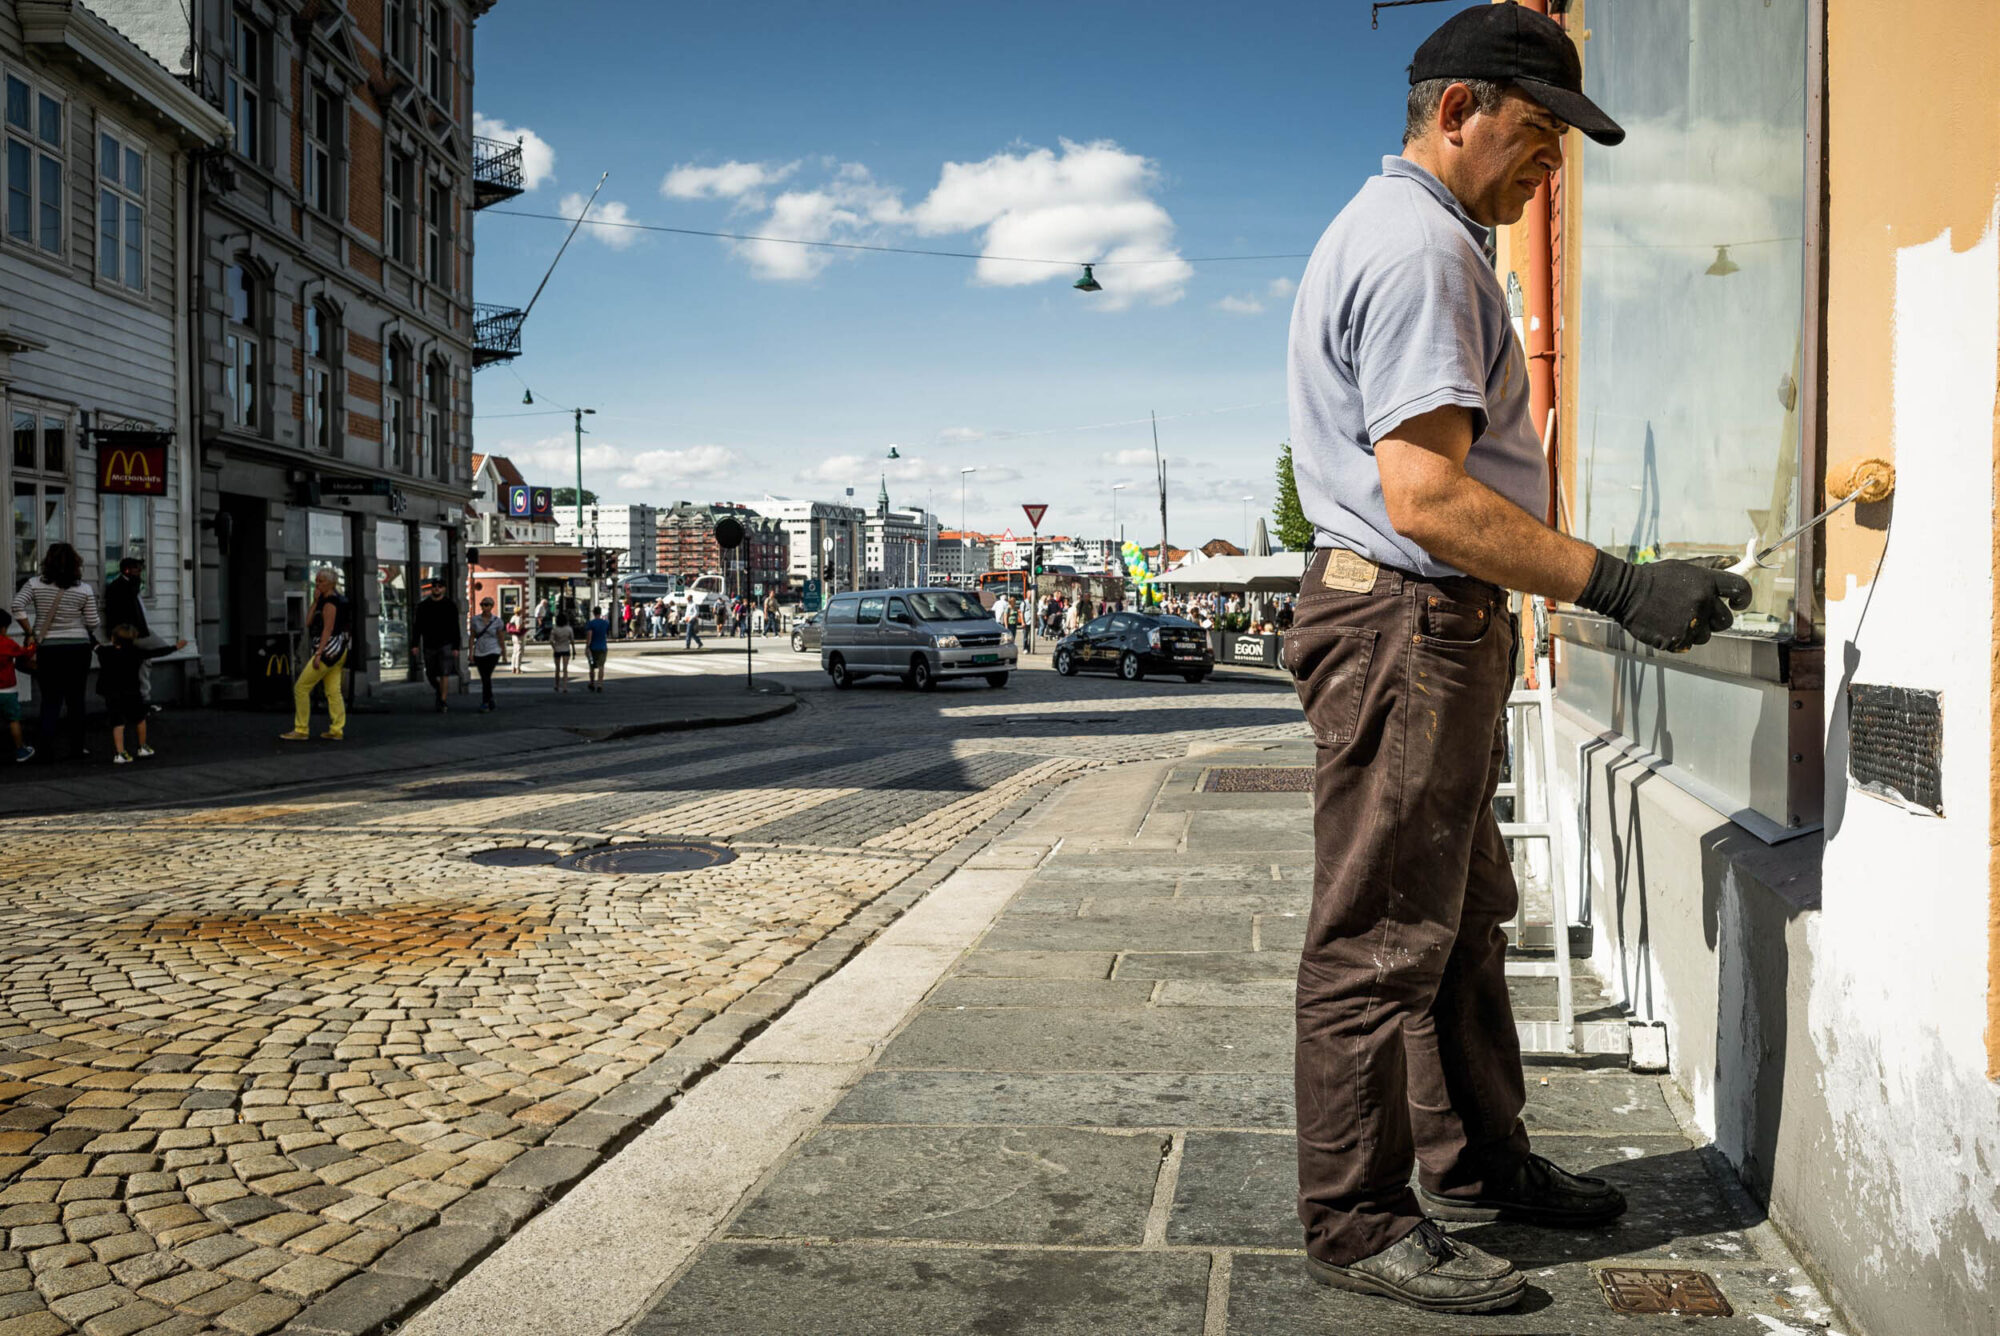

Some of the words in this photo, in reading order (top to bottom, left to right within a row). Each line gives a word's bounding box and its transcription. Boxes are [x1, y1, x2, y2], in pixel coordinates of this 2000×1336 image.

[516, 495, 524, 506] N
[536, 495, 545, 506] N
[1234, 642, 1264, 656] EGON
